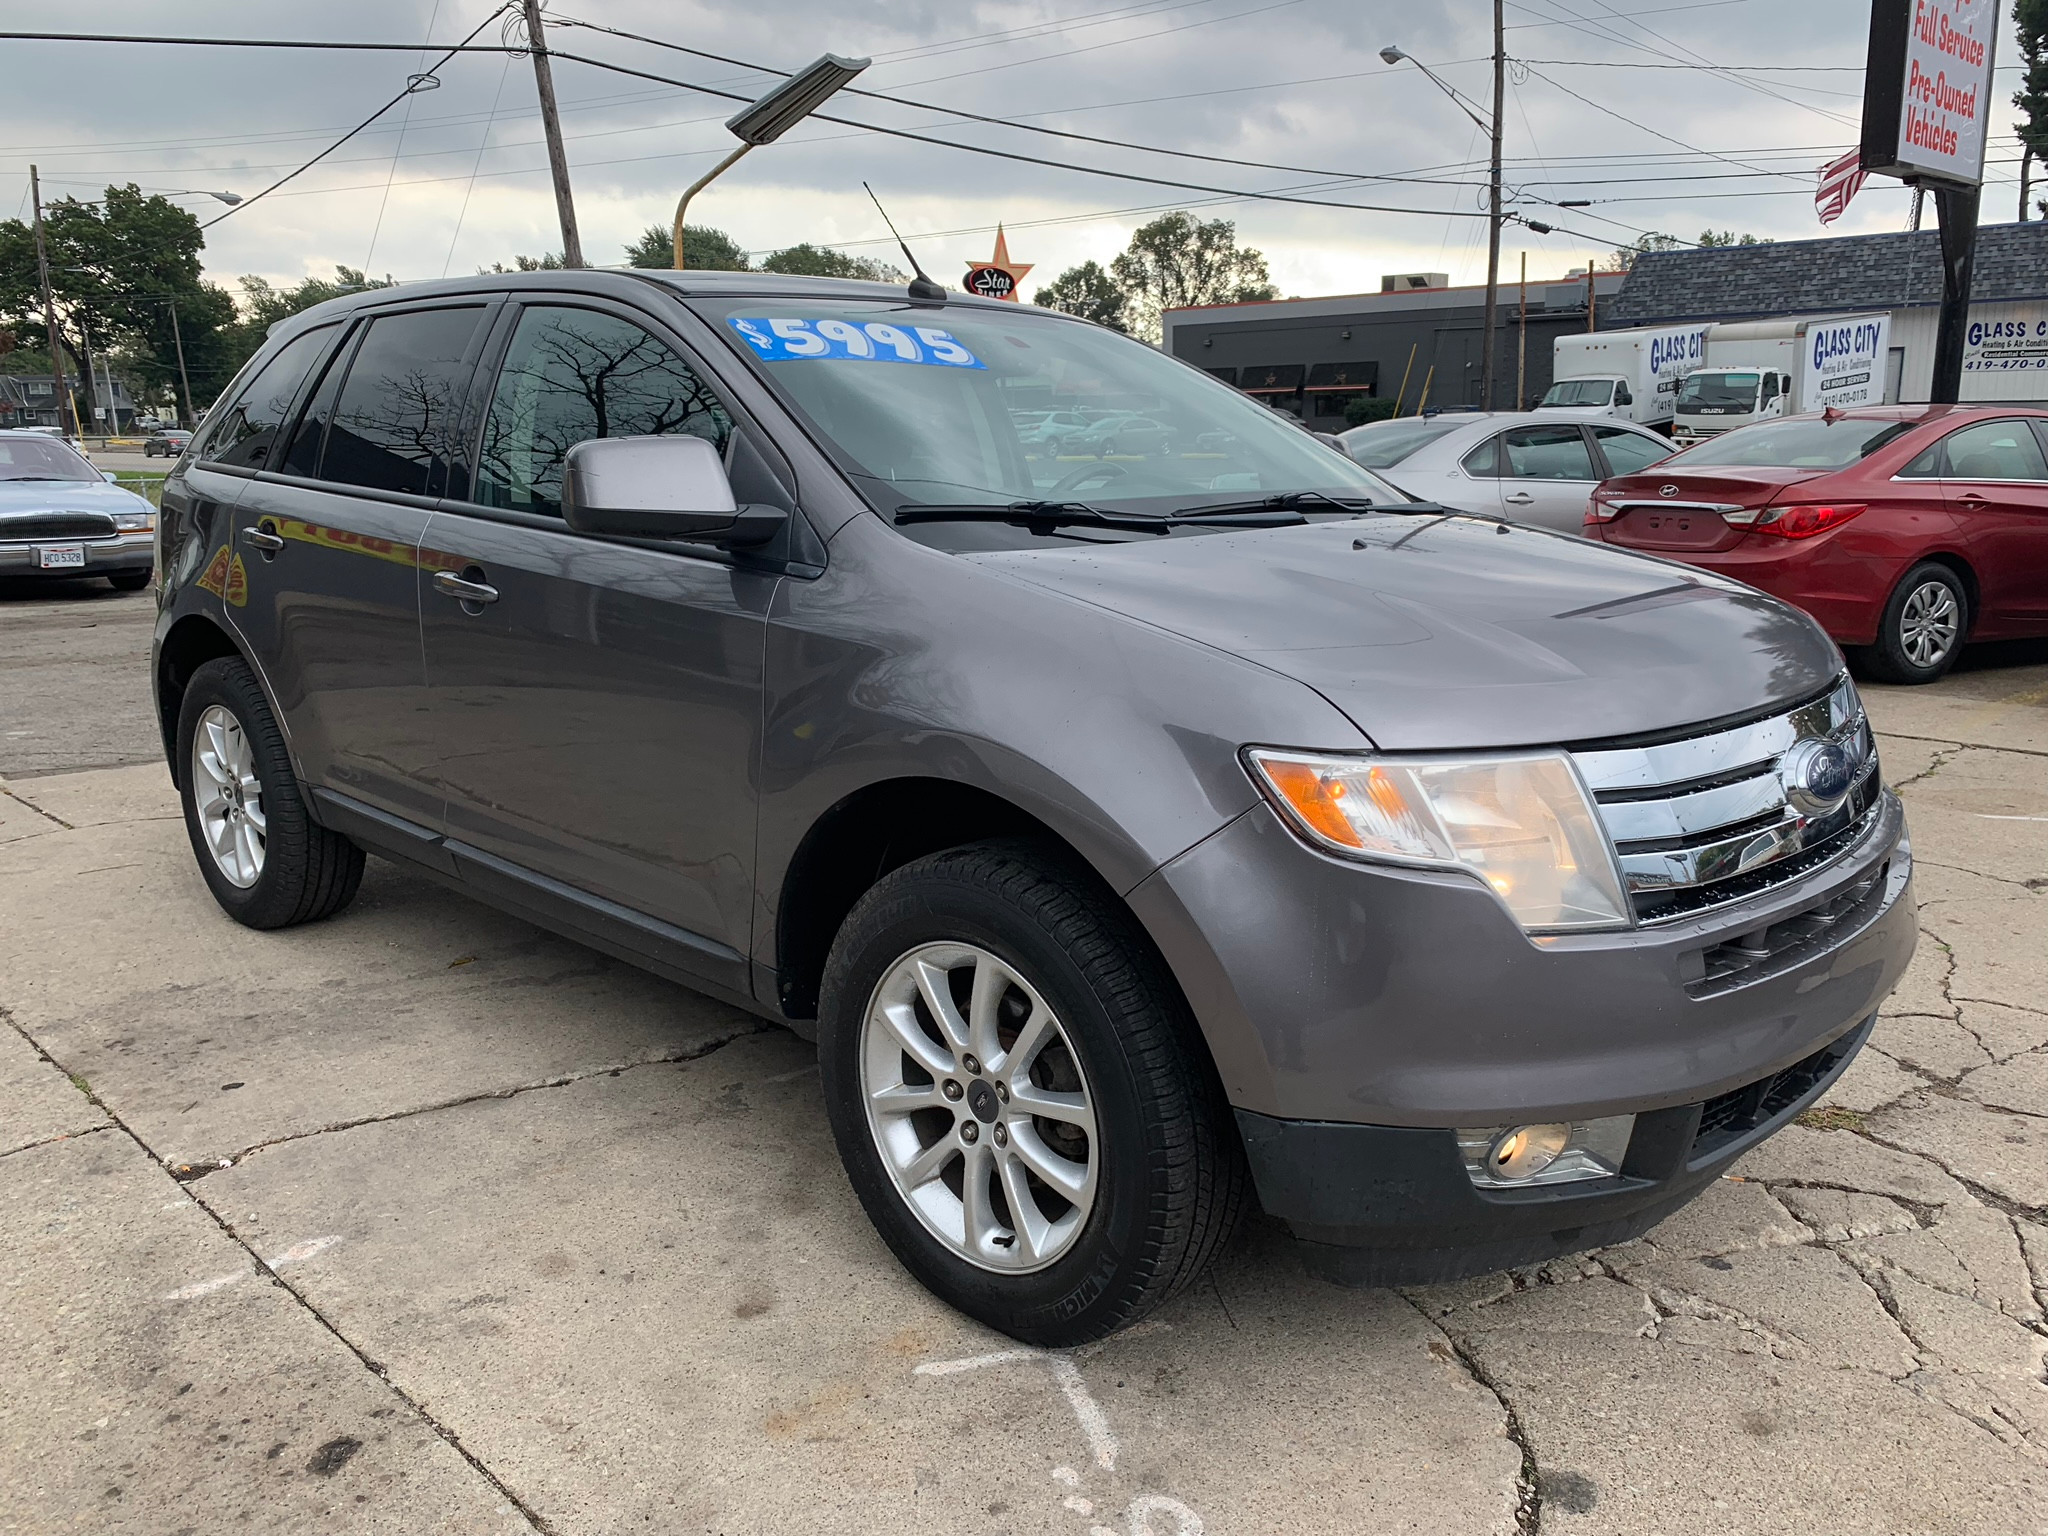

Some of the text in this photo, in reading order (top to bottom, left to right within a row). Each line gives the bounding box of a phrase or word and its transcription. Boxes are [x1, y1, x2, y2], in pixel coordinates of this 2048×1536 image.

[1914, 0, 1984, 68] Full Service
[1908, 58, 1977, 120] Pre-Owned
[1905, 104, 1958, 156] Vehicles
[975, 268, 1010, 289] Star
[734, 317, 976, 366] $5995
[1814, 321, 1881, 370] GLASS CITY
[1968, 321, 2026, 346] GLASS
[1982, 341, 2005, 349] Heating
[2007, 340, 2012, 348] &
[2013, 339, 2024, 348] Air
[1651, 331, 1703, 374] GLASS CIT
[1965, 359, 2048, 370] 419-470-0
[1822, 373, 1869, 389] 24 HOUR SERVICE
[61, 552, 81, 563] 5328
